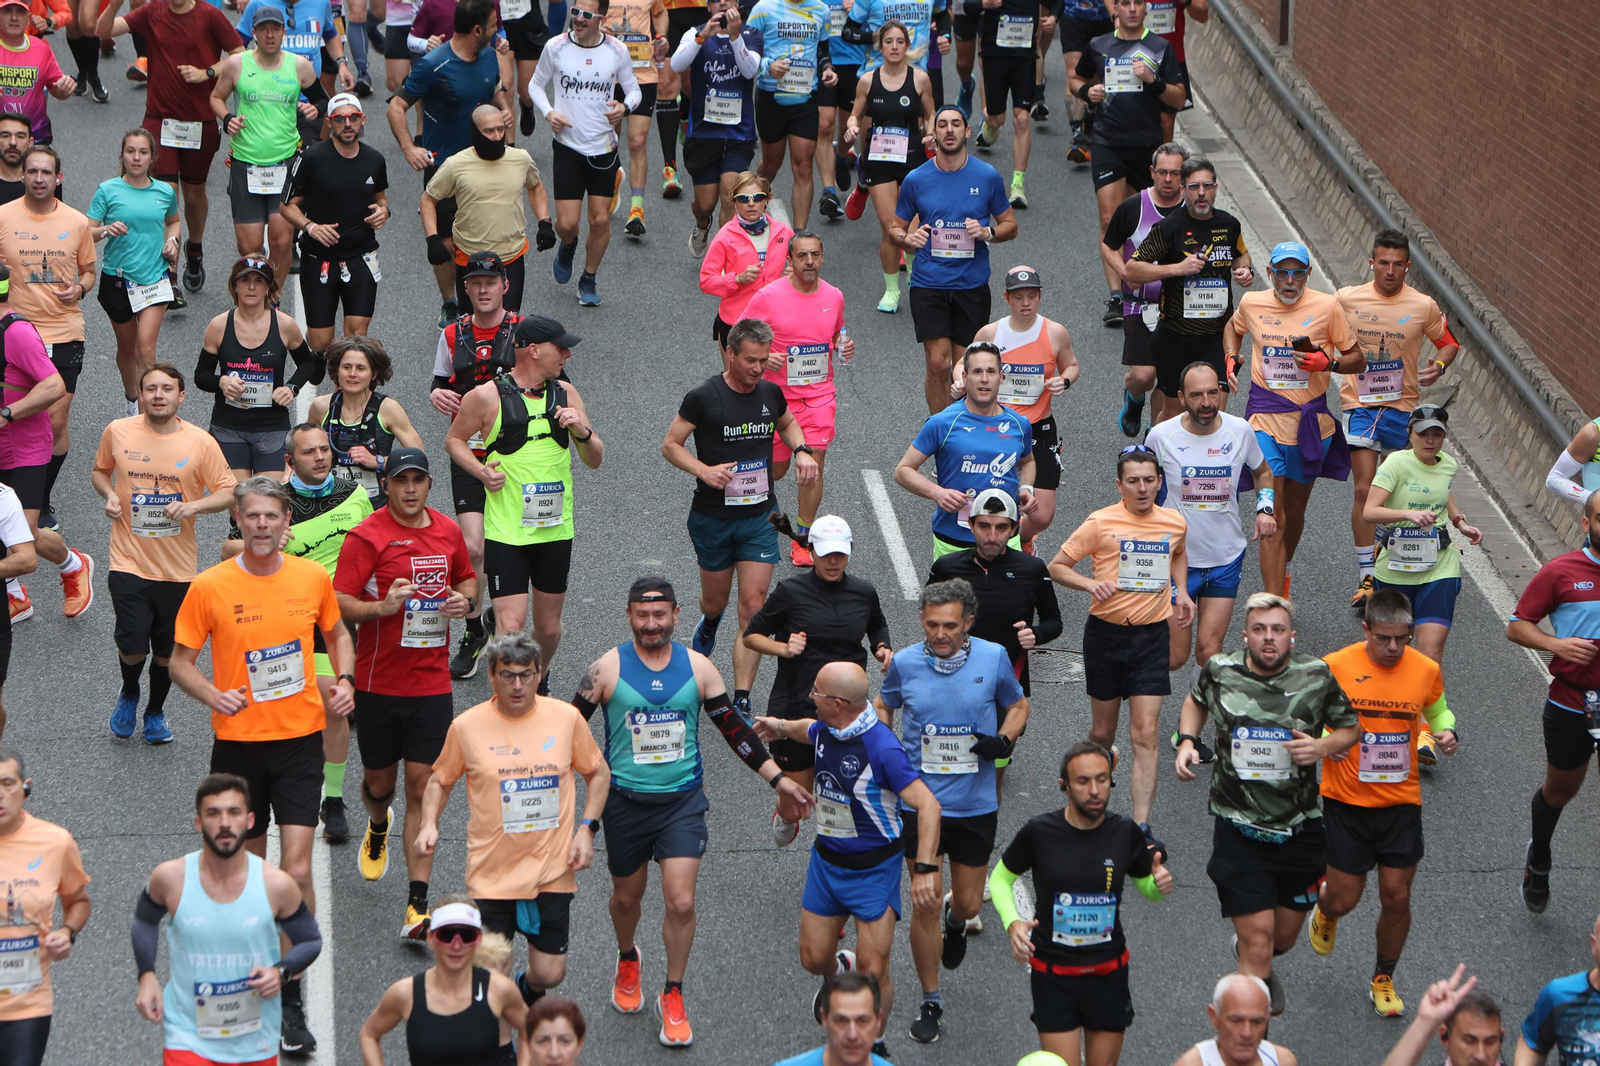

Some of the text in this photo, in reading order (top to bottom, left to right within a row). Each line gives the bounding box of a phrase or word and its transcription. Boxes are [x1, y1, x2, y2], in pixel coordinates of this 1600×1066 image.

[777, 22, 818, 31] DEPORTIVO
[777, 30, 818, 39] CHARQUITO
[246, 90, 259, 100] Las
[883, 127, 906, 136] ZURICH
[945, 233, 961, 241] 6760
[1208, 250, 1234, 262] BIKE
[1198, 292, 1214, 300] 9184
[1357, 328, 1380, 337] Maratón
[802, 345, 826, 354] ZURICH
[801, 359, 817, 367] 8482
[1277, 362, 1294, 370] 7594
[1372, 362, 1398, 370] ZURICH
[797, 369, 822, 377] FLAMENCO
[1013, 365, 1040, 373] ZURICH
[1372, 375, 1390, 384] 6485
[723, 421, 775, 437] Run2Forty2
[740, 461, 763, 471] ZURICH
[960, 460, 989, 474] Run
[128, 470, 154, 479] Maratón
[1199, 468, 1227, 476] ZURICH
[741, 475, 757, 485] 7358
[1198, 482, 1216, 491] 7295
[743, 488, 757, 496] PAUL
[148, 496, 177, 504] ZURICH
[538, 499, 554, 507] 8924
[1408, 501, 1430, 510] Maratón
[1403, 529, 1431, 537] ZURICH
[1137, 543, 1164, 552] ZURICH
[1402, 543, 1420, 551] 8281
[1135, 558, 1153, 567] 9358
[1573, 580, 1595, 590] NEO
[421, 617, 439, 625] 8593
[264, 643, 296, 658] ZURICH
[267, 663, 288, 676] 9413
[1350, 697, 1410, 709] NEWMOVE
[649, 712, 679, 722] ZURICH
[940, 725, 971, 734] ZURICH
[650, 730, 670, 739] 9879
[1252, 730, 1286, 740] ZURICH
[1379, 734, 1408, 743] ZURICH
[640, 744, 667, 752] AMANCIO
[939, 742, 959, 751] 8416
[1250, 747, 1272, 756] 9042
[1378, 751, 1398, 760] 8040
[941, 755, 958, 763] RAFA
[498, 764, 528, 775] Maratón
[1246, 761, 1276, 770] Wheatley
[520, 778, 553, 789] ZURICH
[822, 788, 845, 802] ZURICH
[521, 796, 542, 807] 8225
[821, 804, 837, 816] 8630
[525, 811, 541, 820] Jordi
[1075, 896, 1110, 905] ZURICH
